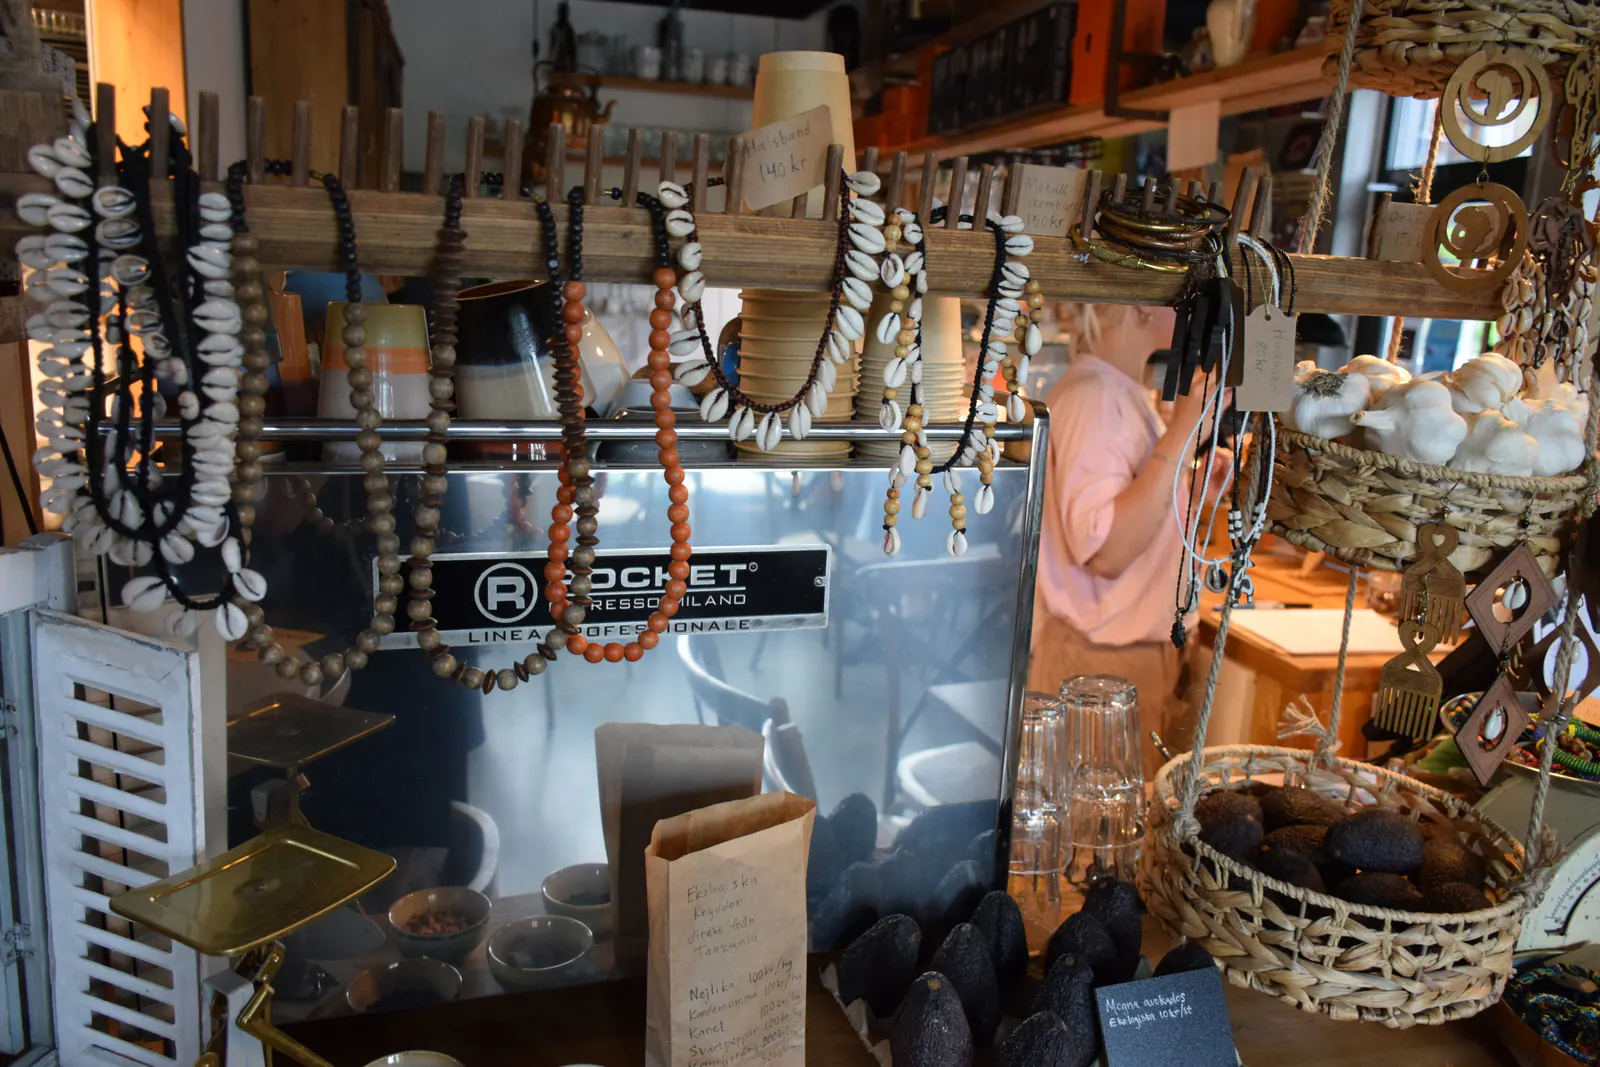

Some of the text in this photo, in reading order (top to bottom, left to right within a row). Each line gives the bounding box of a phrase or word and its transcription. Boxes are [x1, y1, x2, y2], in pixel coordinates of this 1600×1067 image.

[745, 121, 811, 158] Halsband
[759, 154, 807, 184] 140 kr
[549, 597, 660, 612] RESSO
[469, 629, 541, 643] LINEA
[689, 1021, 725, 1040] Kanel
